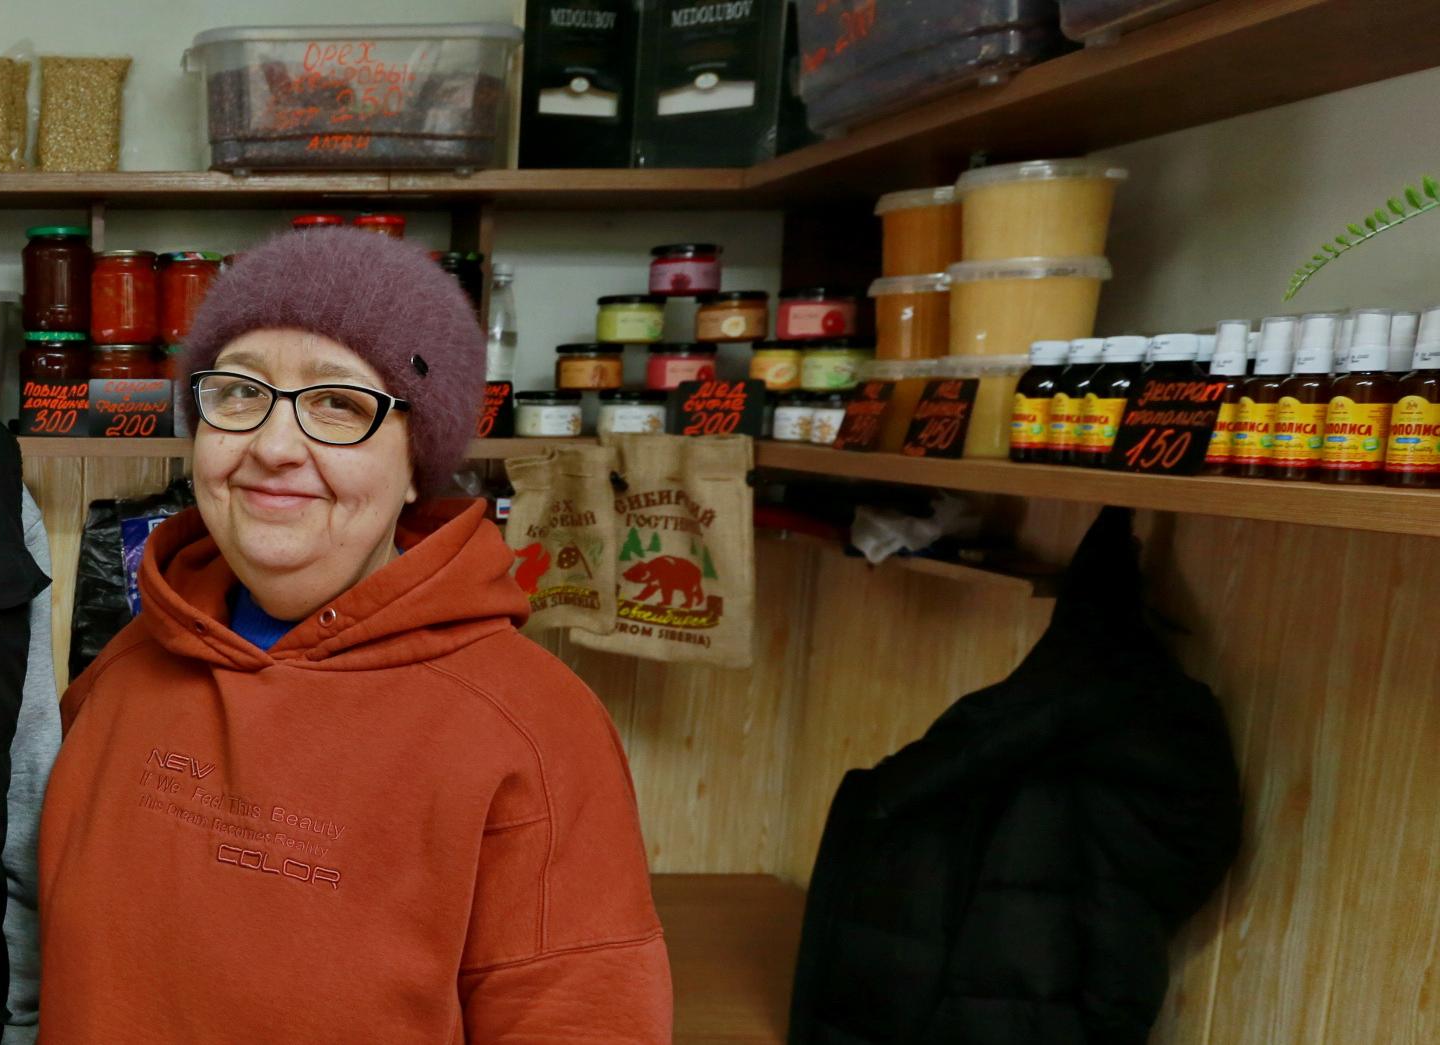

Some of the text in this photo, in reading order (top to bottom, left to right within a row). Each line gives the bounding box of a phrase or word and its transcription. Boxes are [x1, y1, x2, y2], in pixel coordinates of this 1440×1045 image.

[671, 0, 752, 28] MEDOLUBOV
[30, 409, 77, 433] 300
[105, 413, 158, 437] 200
[683, 412, 741, 436] 200
[1125, 427, 1193, 469] 150
[146, 748, 216, 779] NEW
[156, 774, 182, 794] We
[227, 797, 261, 819] This
[270, 805, 347, 841] Beauty
[216, 843, 342, 891] COLOR
